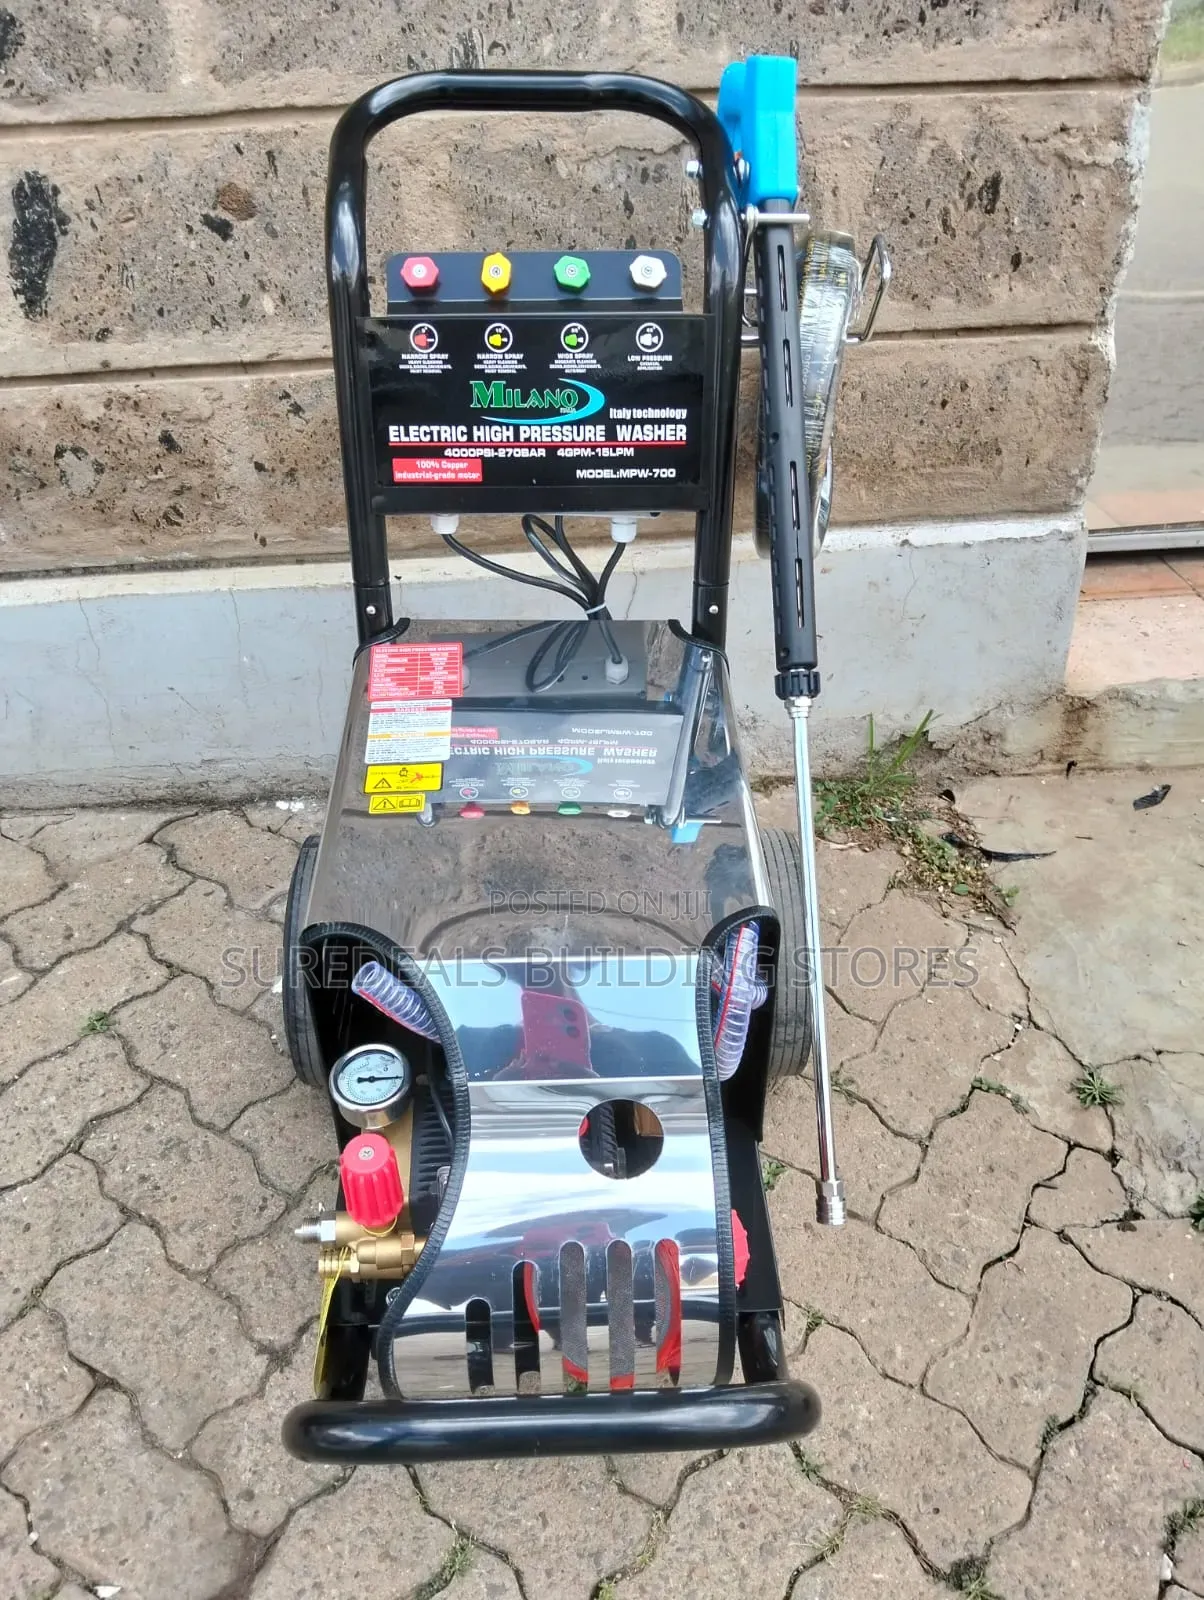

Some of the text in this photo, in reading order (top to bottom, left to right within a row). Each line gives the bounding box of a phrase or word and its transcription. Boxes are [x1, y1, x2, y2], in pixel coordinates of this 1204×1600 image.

[469, 380, 579, 409] MILANO
[609, 407, 687, 420] Italy technology
[388, 424, 687, 442] ELECTRIC HIGH PRESSURE WASHER
[444, 447, 635, 458] 4000PSI-270BAR 4GPM-15LPM
[415, 460, 468, 470] 100% Copper
[576, 468, 676, 478] MODEL:MPW-700
